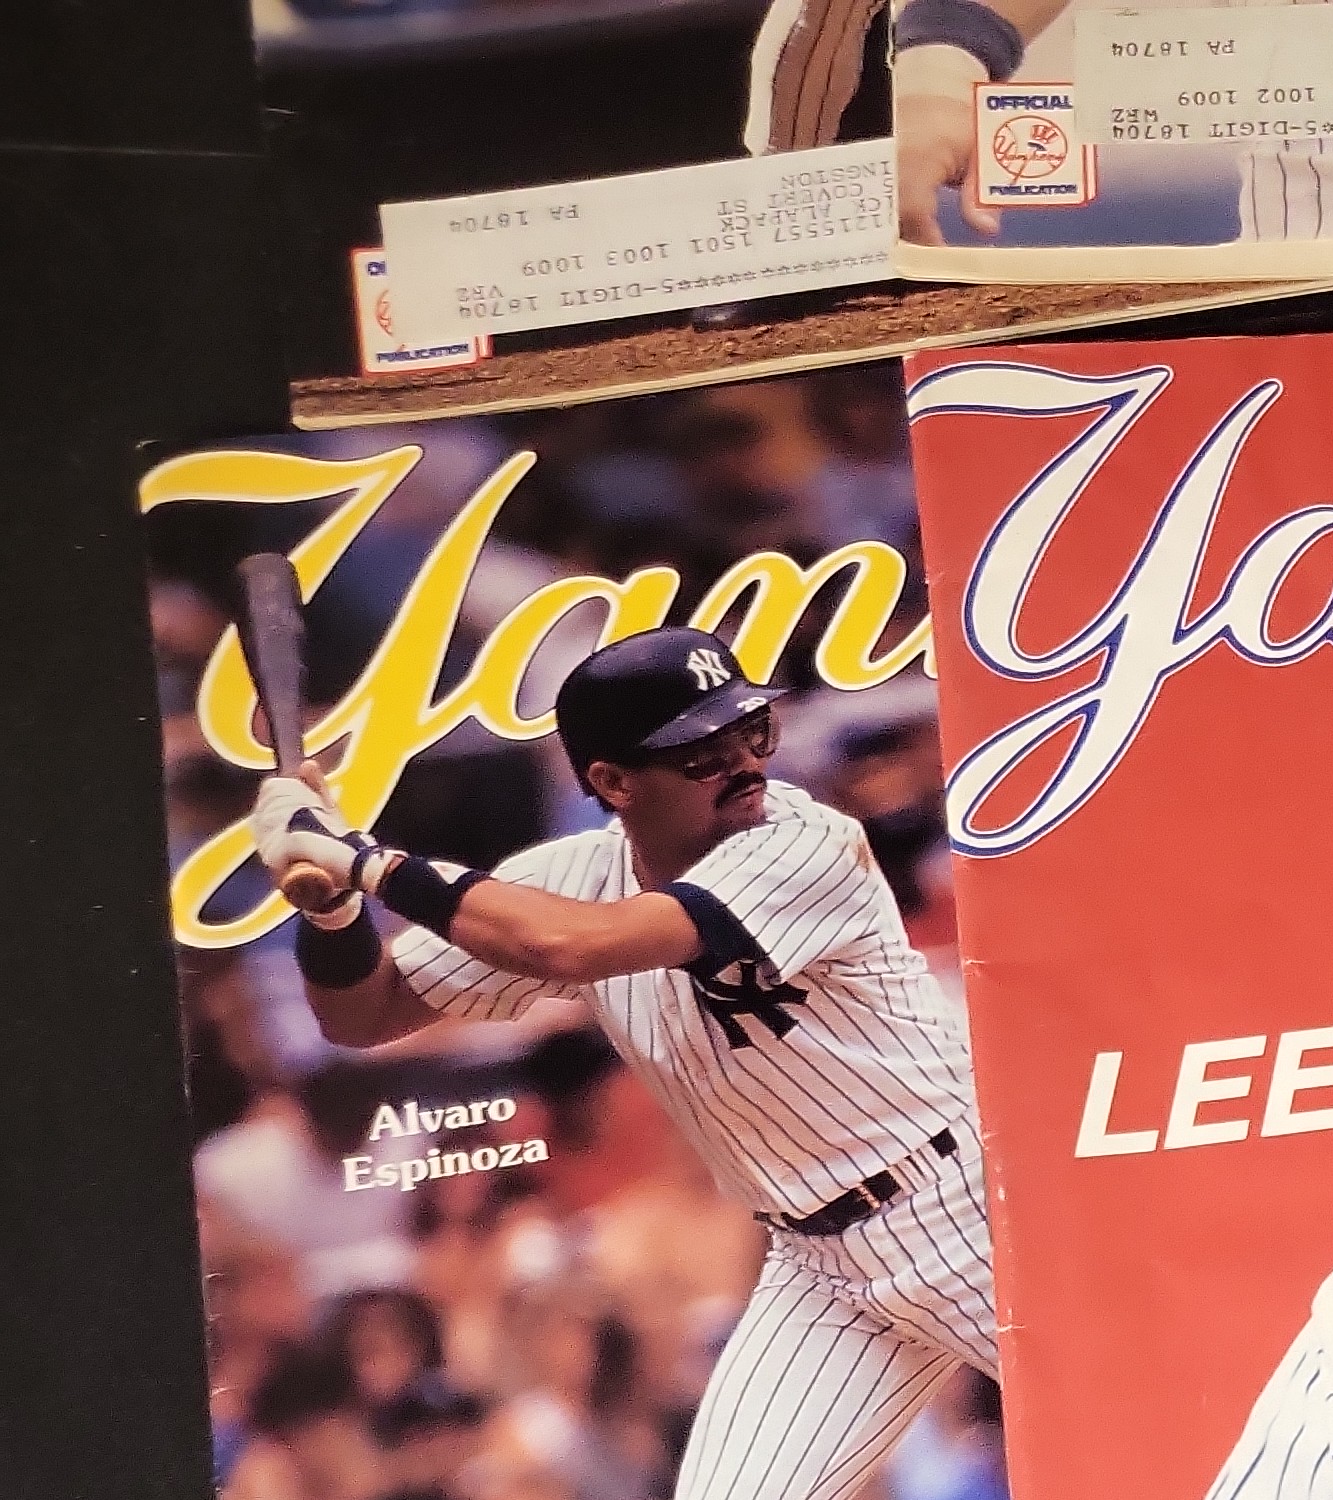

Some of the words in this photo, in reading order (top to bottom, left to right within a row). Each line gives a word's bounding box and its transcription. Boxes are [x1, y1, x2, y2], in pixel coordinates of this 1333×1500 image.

[1112, 40, 1189, 57] 18704
[1207, 39, 1236, 55] PA
[1178, 90, 1237, 106] 1009
[1257, 87, 1315, 104] 1002
[1112, 124, 1190, 140] 18704
[690, 233, 752, 254] 1501
[606, 243, 669, 266] 1003
[522, 255, 584, 276] 1009
[368, 1096, 517, 1142] Alvaro
[342, 1135, 549, 1193] Espinoza
